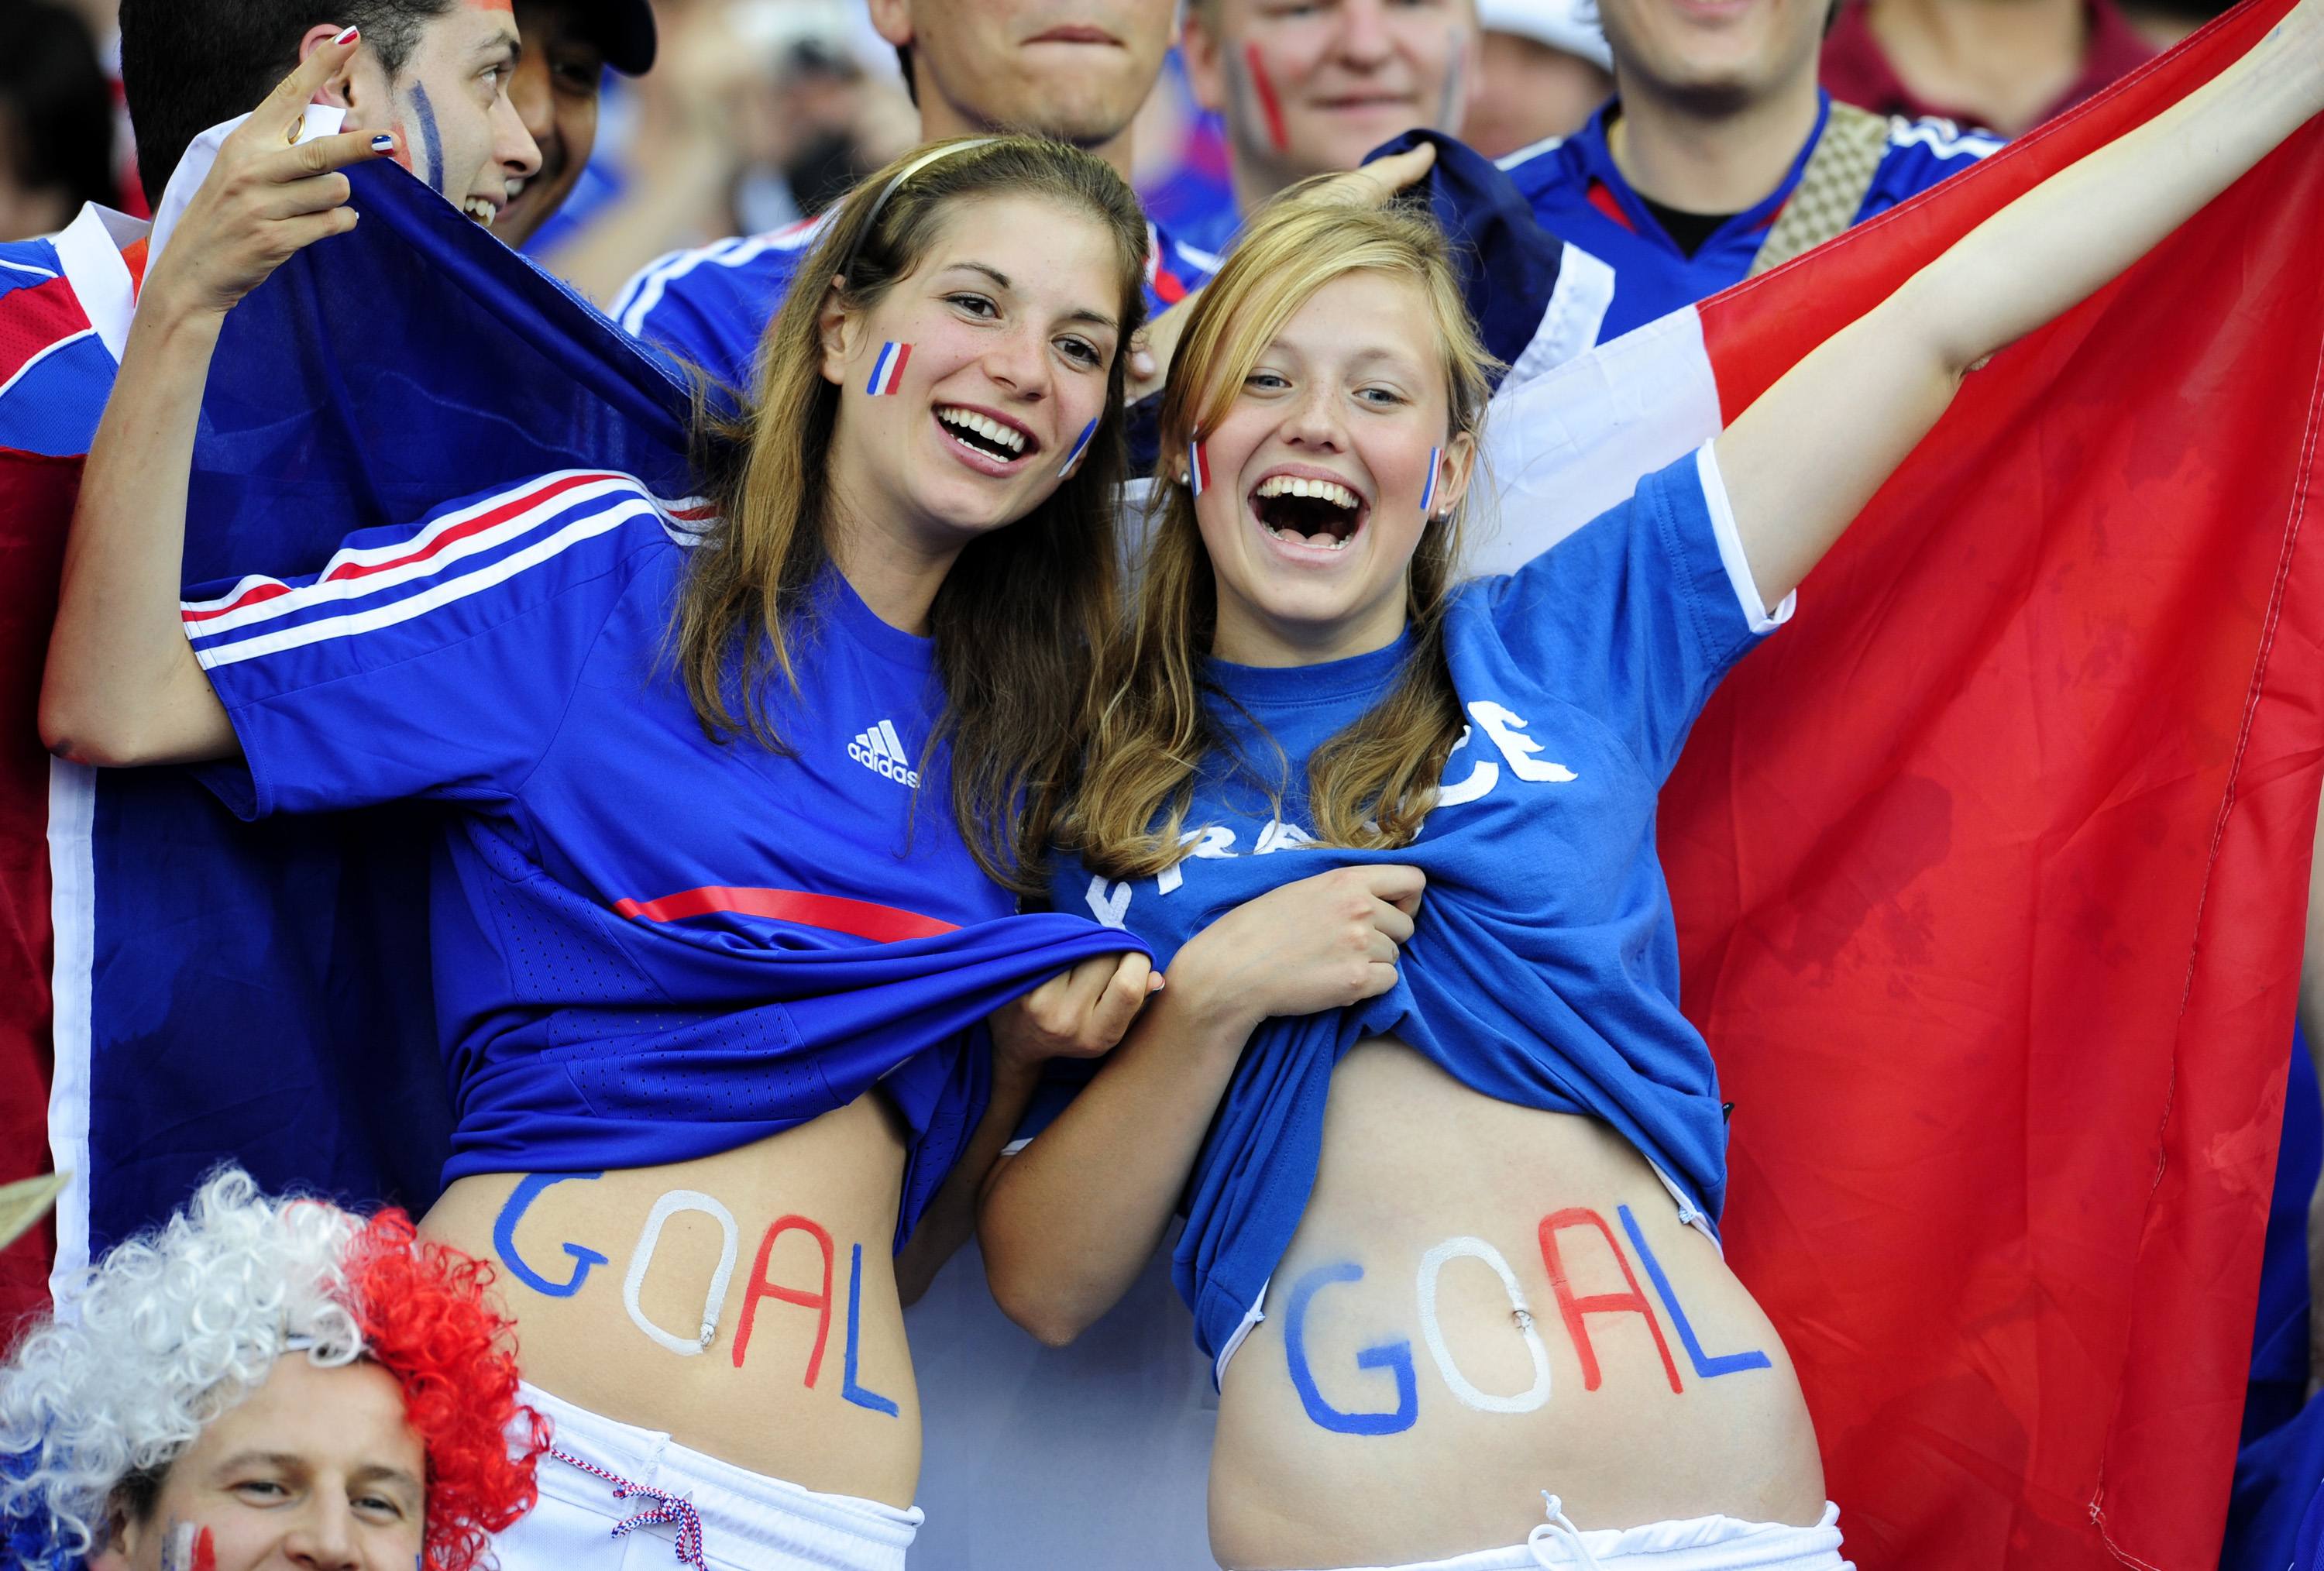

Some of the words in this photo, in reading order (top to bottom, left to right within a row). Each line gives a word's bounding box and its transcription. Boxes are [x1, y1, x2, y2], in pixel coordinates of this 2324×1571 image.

[847, 742, 920, 789] adidas
[493, 1172, 899, 1418] GOAL
[1284, 1204, 1772, 1435] GOAL
